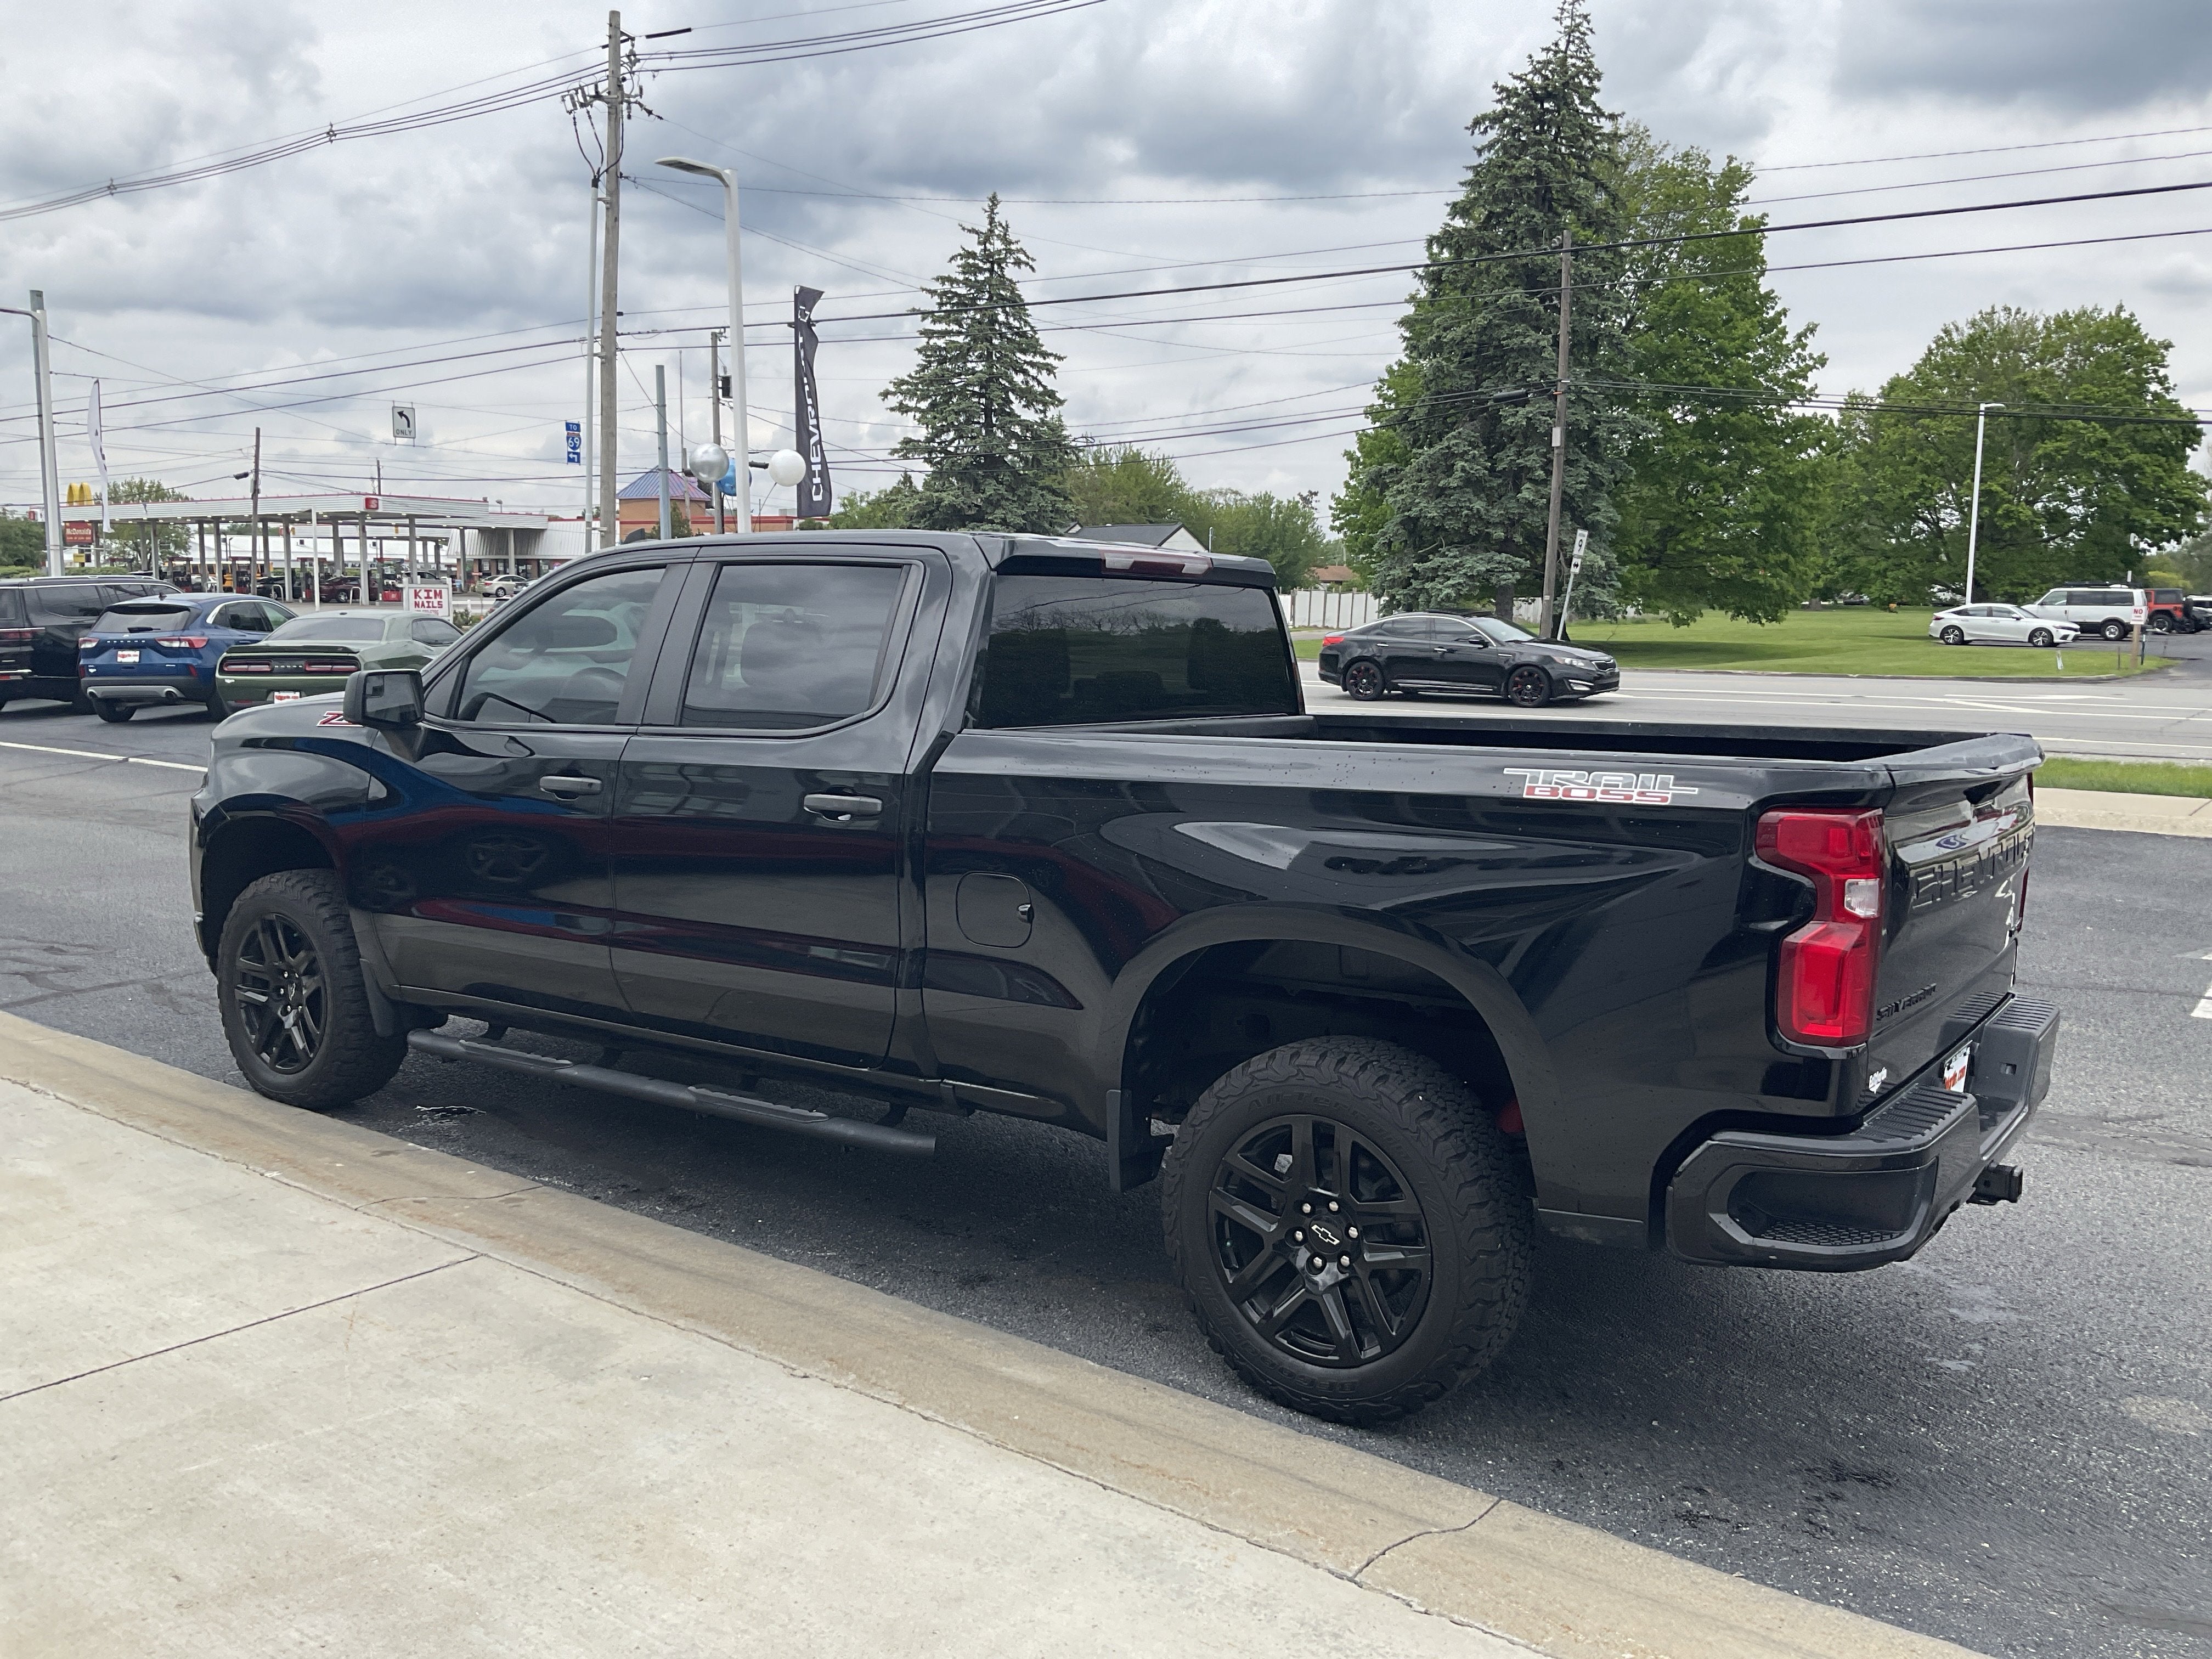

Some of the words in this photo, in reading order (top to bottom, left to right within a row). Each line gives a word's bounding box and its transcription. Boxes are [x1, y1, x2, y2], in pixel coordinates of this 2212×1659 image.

[568, 437, 580, 448] 69
[1578, 539, 1583, 553] 9
[414, 589, 443, 600] KIM
[414, 600, 443, 609] NAILS
[1503, 768, 1699, 795] TRAIL
[1523, 783, 1671, 805] BOSS
